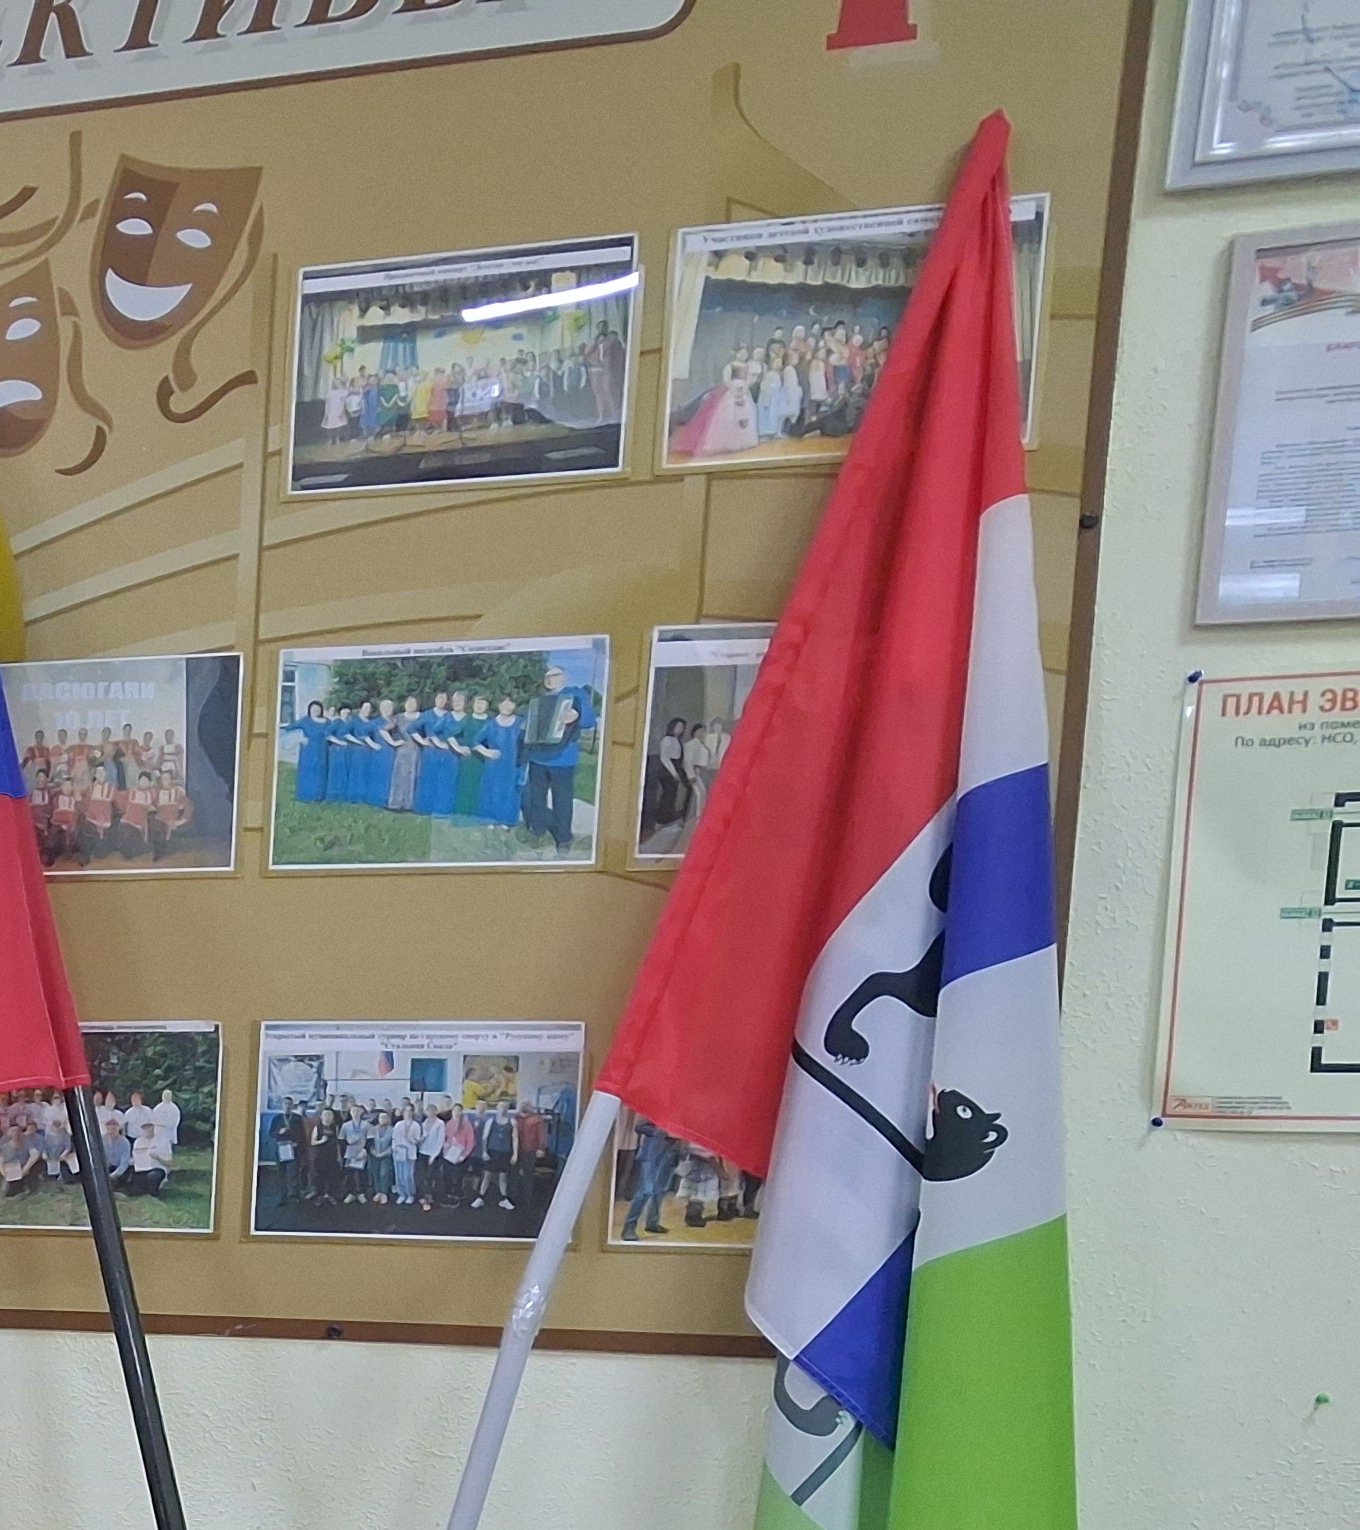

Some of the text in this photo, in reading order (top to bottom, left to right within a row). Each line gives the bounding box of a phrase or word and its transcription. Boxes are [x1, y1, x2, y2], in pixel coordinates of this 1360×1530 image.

[1221, 690, 1309, 717] ПЛАН
[1299, 722, 1315, 731] из
[1235, 732, 1357, 749] По адресу: НСО,
